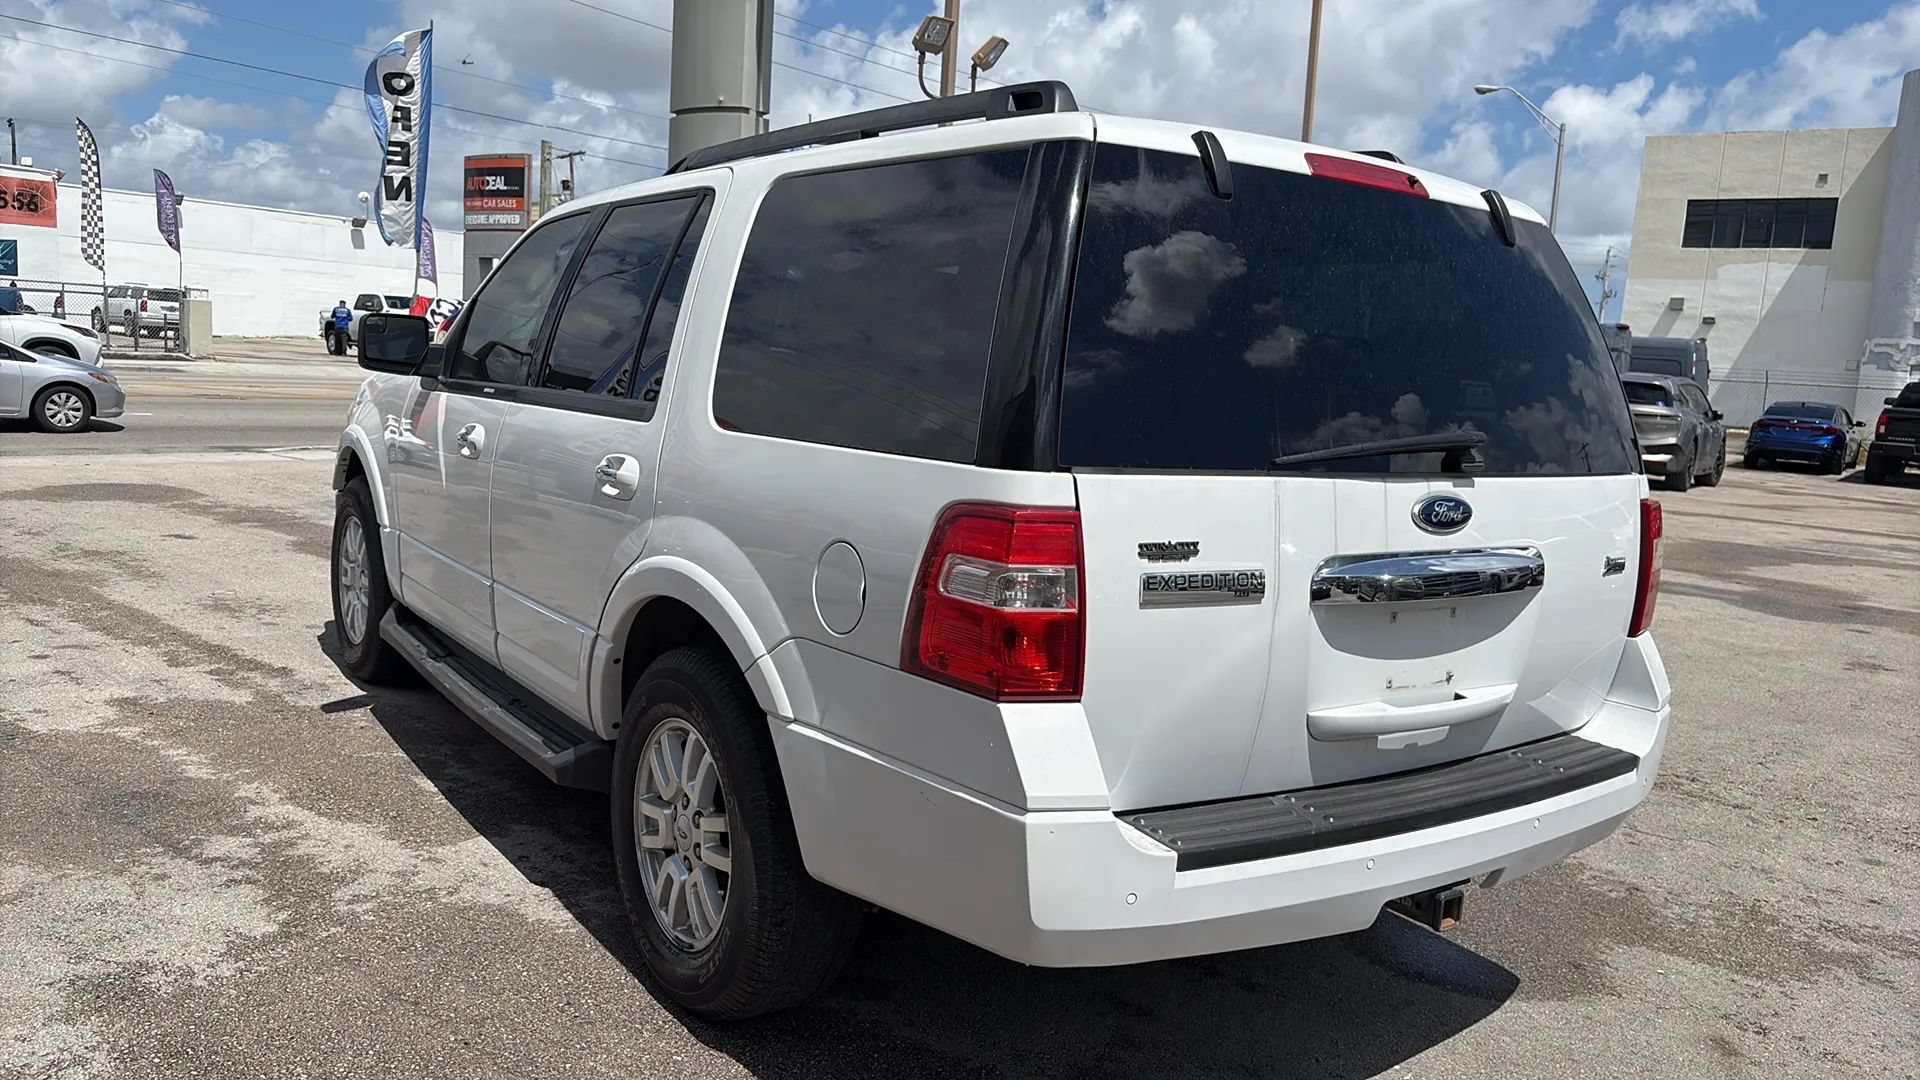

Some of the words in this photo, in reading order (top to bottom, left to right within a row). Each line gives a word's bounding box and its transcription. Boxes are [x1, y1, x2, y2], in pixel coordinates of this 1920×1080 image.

[483, 199, 496, 208] CAR
[497, 199, 517, 208] SALES
[1431, 500, 1470, 523] Ford
[1145, 571, 1263, 591] EXPEDITION
